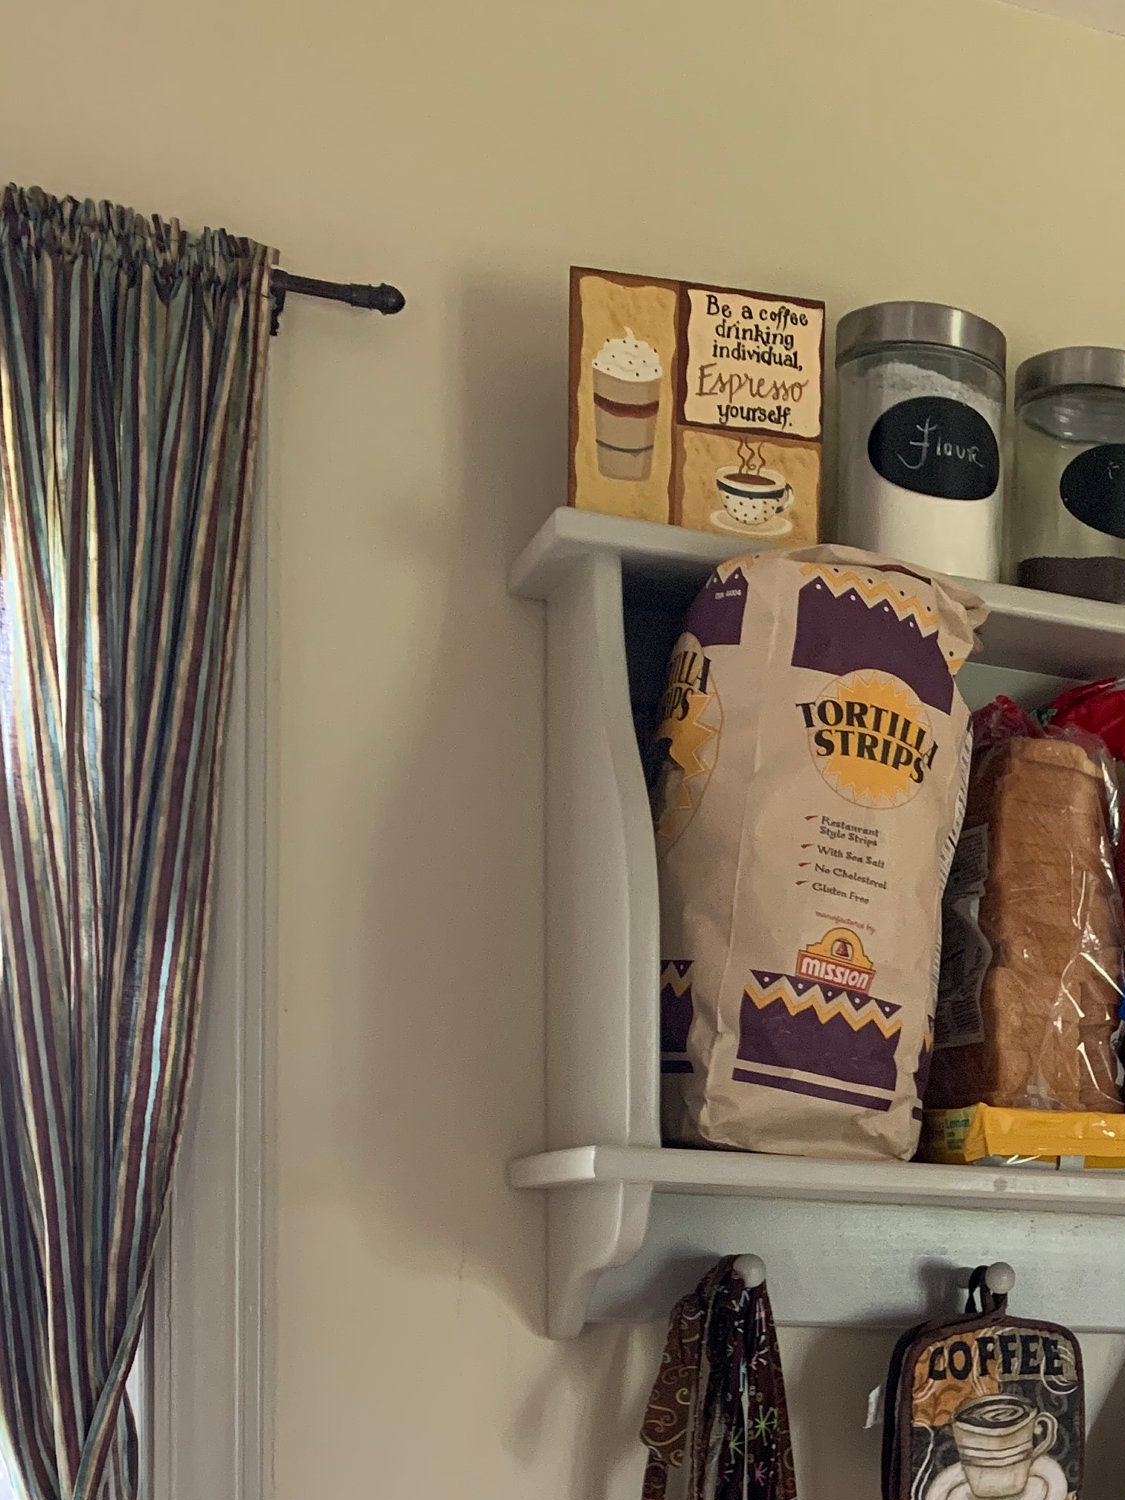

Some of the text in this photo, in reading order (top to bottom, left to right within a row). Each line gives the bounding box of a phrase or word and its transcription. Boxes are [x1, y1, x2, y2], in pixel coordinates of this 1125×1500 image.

[706, 294, 809, 330] Be a coffee
[715, 322, 794, 350] drinking
[711, 340, 803, 371] individual,
[695, 362, 809, 403] Espresso
[717, 404, 793, 430] yourself.
[795, 699, 939, 771] TORTILLA
[814, 728, 926, 783] STRIPS
[820, 825, 878, 848] Style Strips
[821, 815, 880, 838] Restaurant
[817, 844, 885, 869] With Sea Salt
[814, 863, 887, 890] No Cholesterol
[812, 882, 870, 904] Gluten Free
[928, 1334, 1064, 1381] COFFEE
